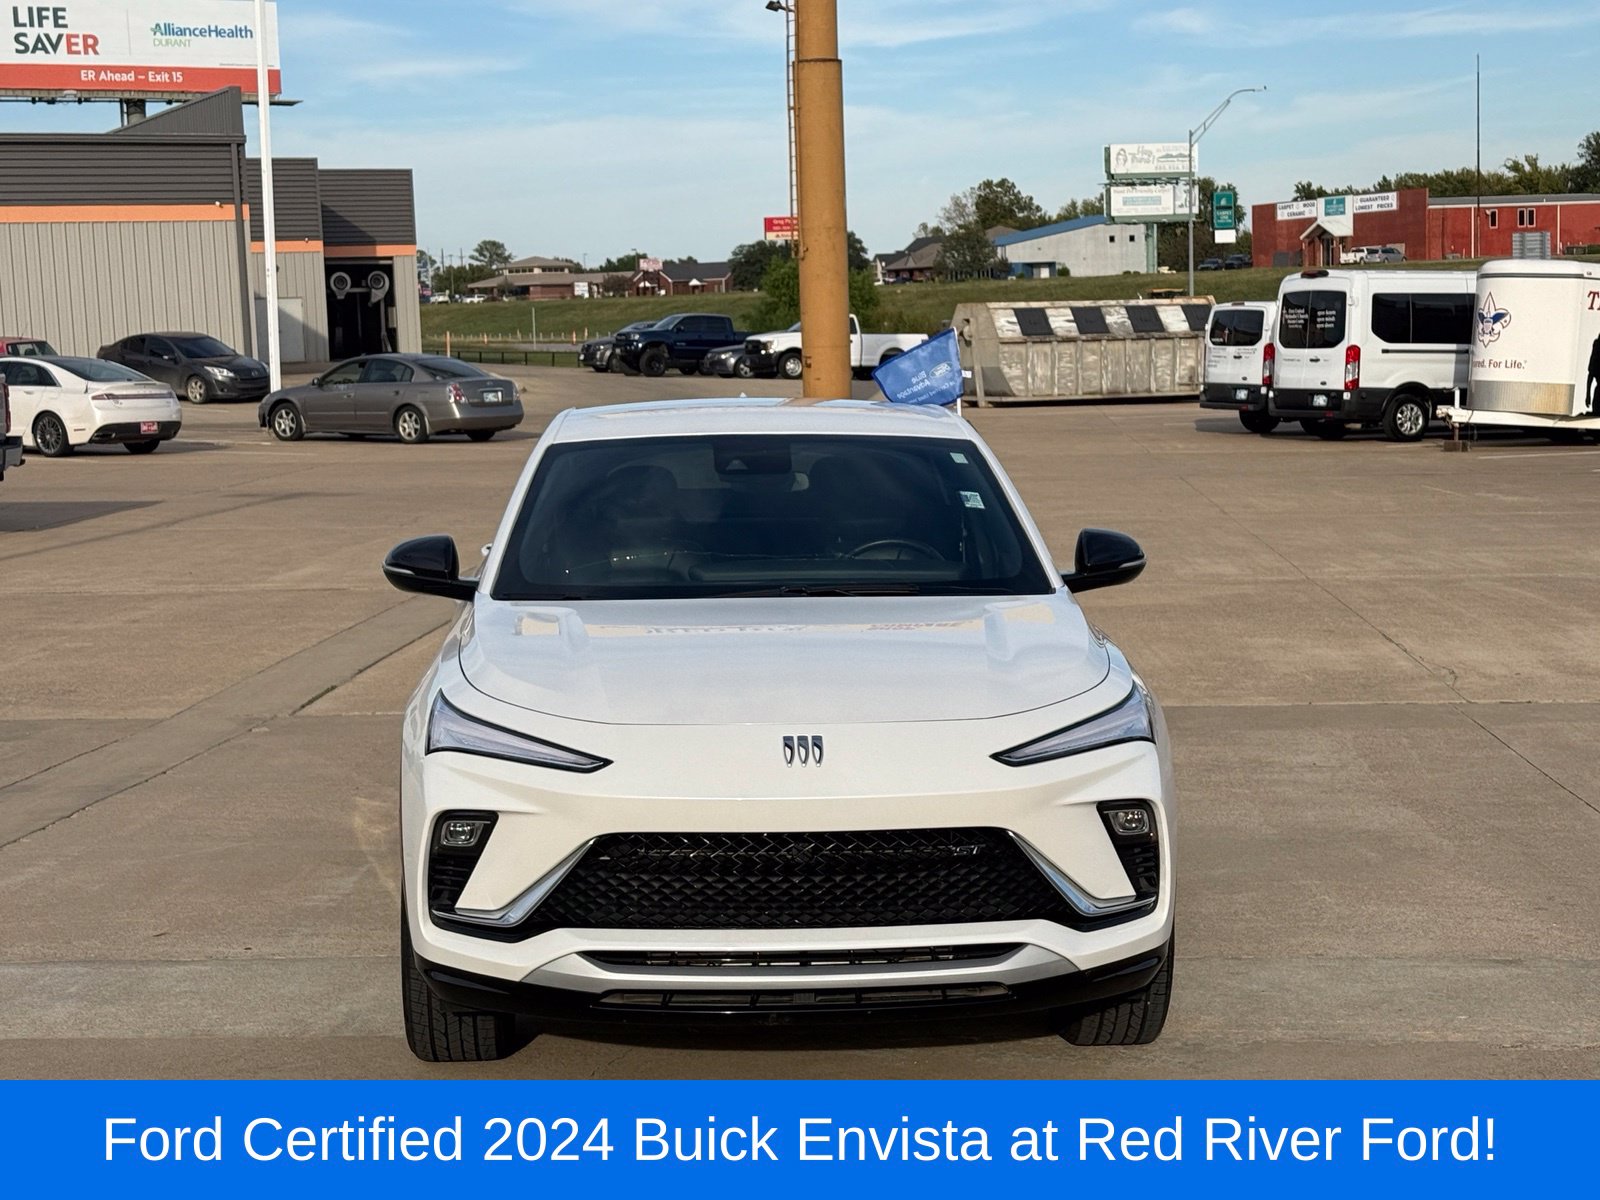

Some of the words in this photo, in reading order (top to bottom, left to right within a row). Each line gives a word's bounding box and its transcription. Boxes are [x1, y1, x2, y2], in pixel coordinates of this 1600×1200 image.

[12, 6, 68, 28] LIFE
[151, 22, 254, 40] AllianceHealth
[14, 32, 100, 56] SAVER
[152, 38, 192, 49] DURANT
[80, 69, 96, 82] ER
[99, 69, 136, 83] Ahead
[148, 71, 170, 84] Exit
[172, 71, 184, 84] 15
[1360, 195, 1390, 203] GUARANTEED
[1355, 204, 1374, 212] LOWEST
[1376, 202, 1394, 210] PRICES
[1488, 359, 1502, 369] For
[1505, 359, 1525, 370] Life.
